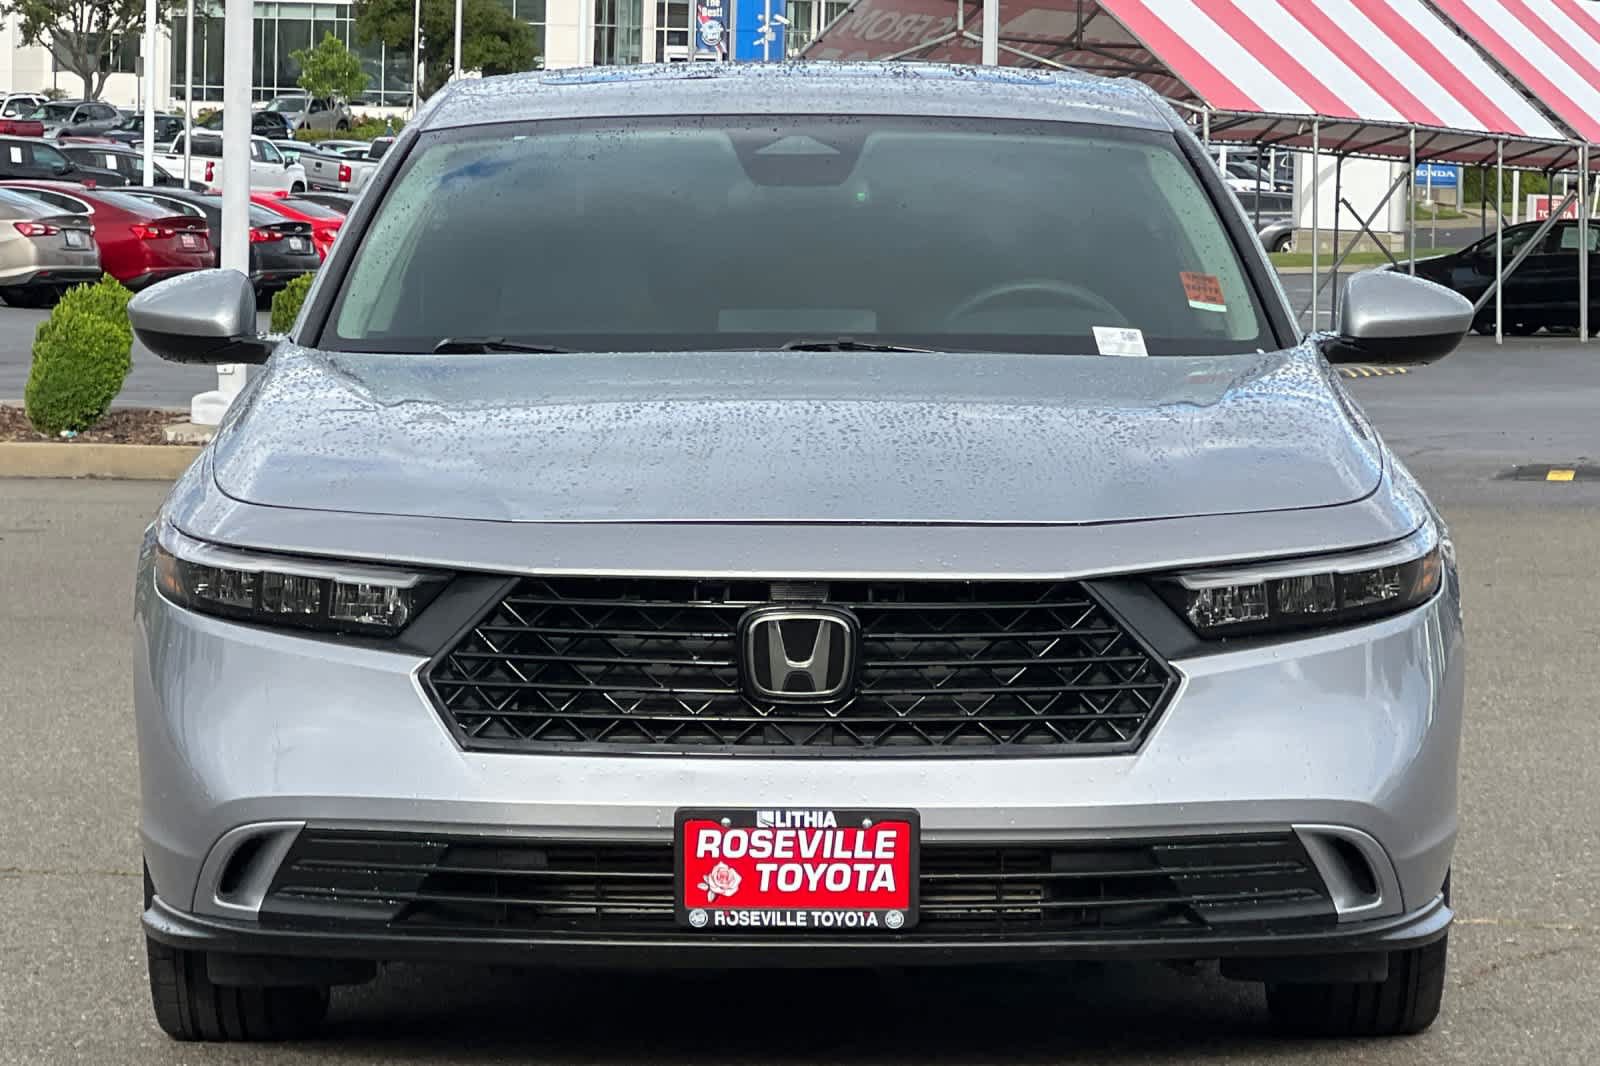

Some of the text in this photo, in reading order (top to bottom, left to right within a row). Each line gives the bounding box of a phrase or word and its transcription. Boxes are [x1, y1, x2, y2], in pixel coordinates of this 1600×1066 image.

[1537, 209, 1573, 219] TOTA
[774, 810, 838, 828] LITHIA
[696, 829, 898, 859] ROSEVILLE
[755, 863, 897, 892] TOYOTA
[714, 911, 879, 927] ROSEVILLE TOYOTA
